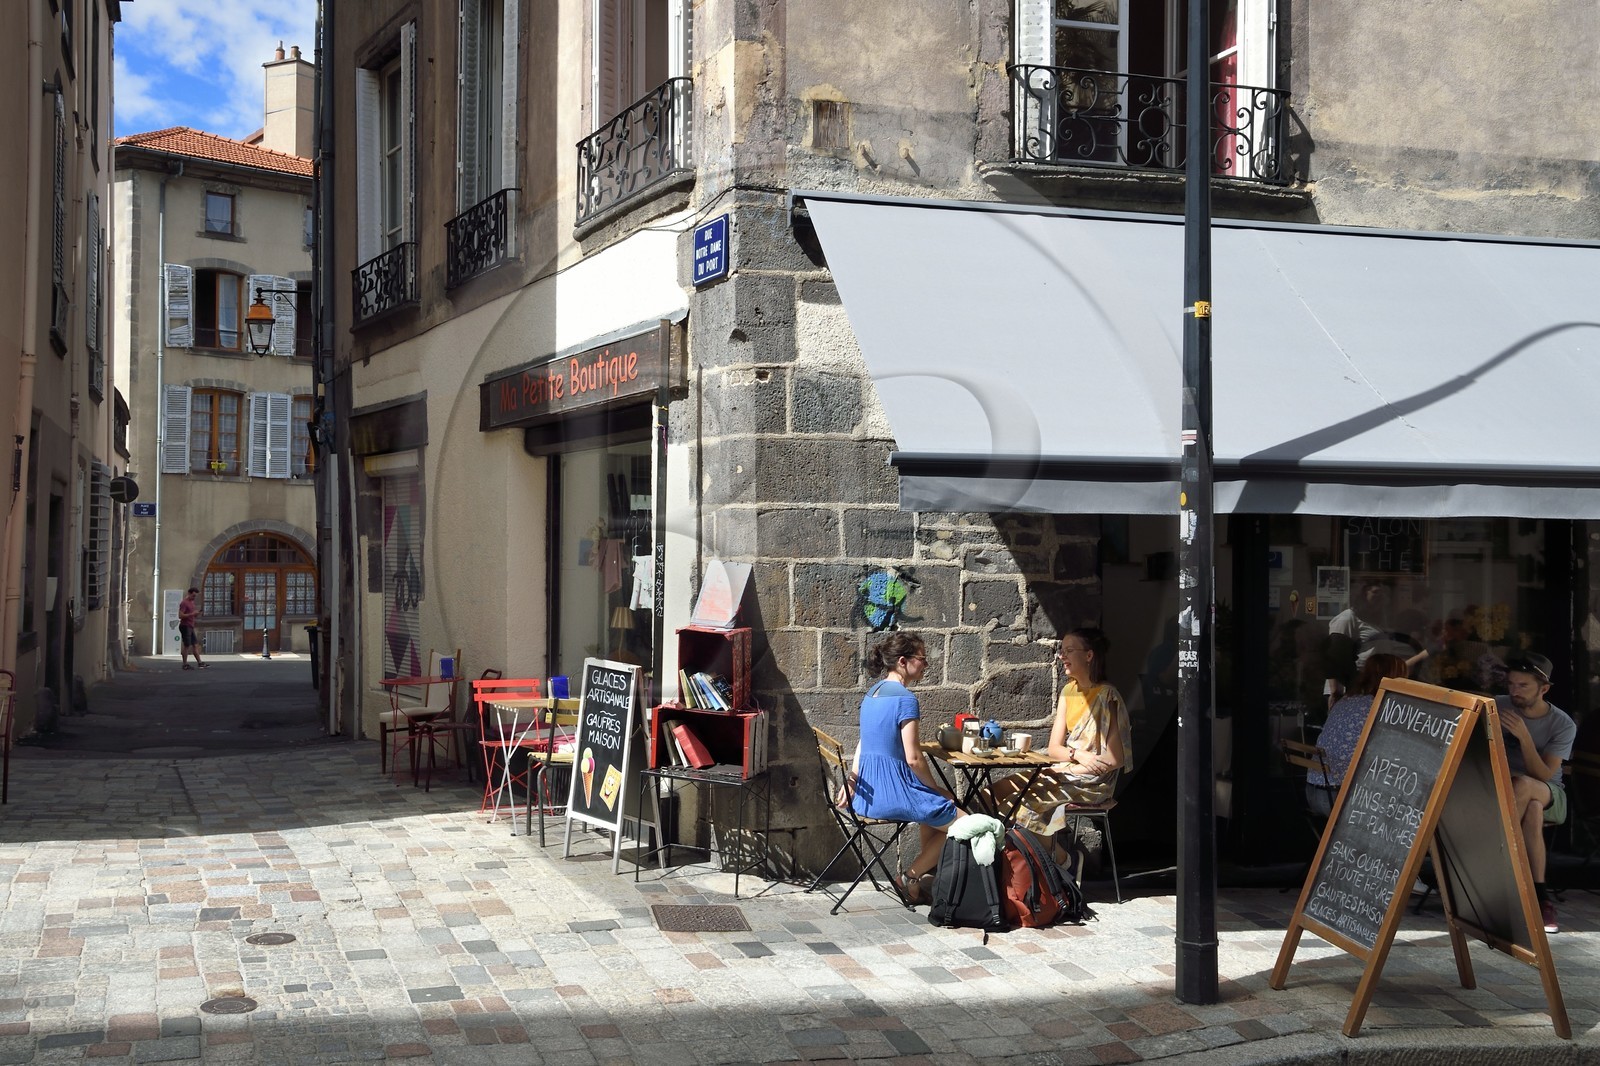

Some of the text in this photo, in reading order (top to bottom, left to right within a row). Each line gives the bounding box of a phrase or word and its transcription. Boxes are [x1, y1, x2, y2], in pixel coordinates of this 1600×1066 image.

[704, 228, 713, 241] RUE
[695, 239, 722, 260] NOTRE DAME
[698, 256, 718, 276] DU PORT
[500, 349, 638, 412] Ma Petite Boutique
[1348, 517, 1421, 536] SALON
[1369, 534, 1394, 551] DE
[591, 669, 627, 691] GLACES
[586, 713, 621, 734] GAUFRES
[1379, 697, 1463, 746] NOUVEAUTÉ
[1364, 755, 1418, 796] APÉRO
[1348, 809, 1417, 849] ET PLANCHES
[1331, 840, 1400, 885] SANS OUBLIER
[1335, 860, 1365, 888] TOUTE
[1363, 877, 1395, 906] HEURE
[1316, 881, 1358, 911] GAUFRES
[1309, 897, 1337, 922] GLACES
